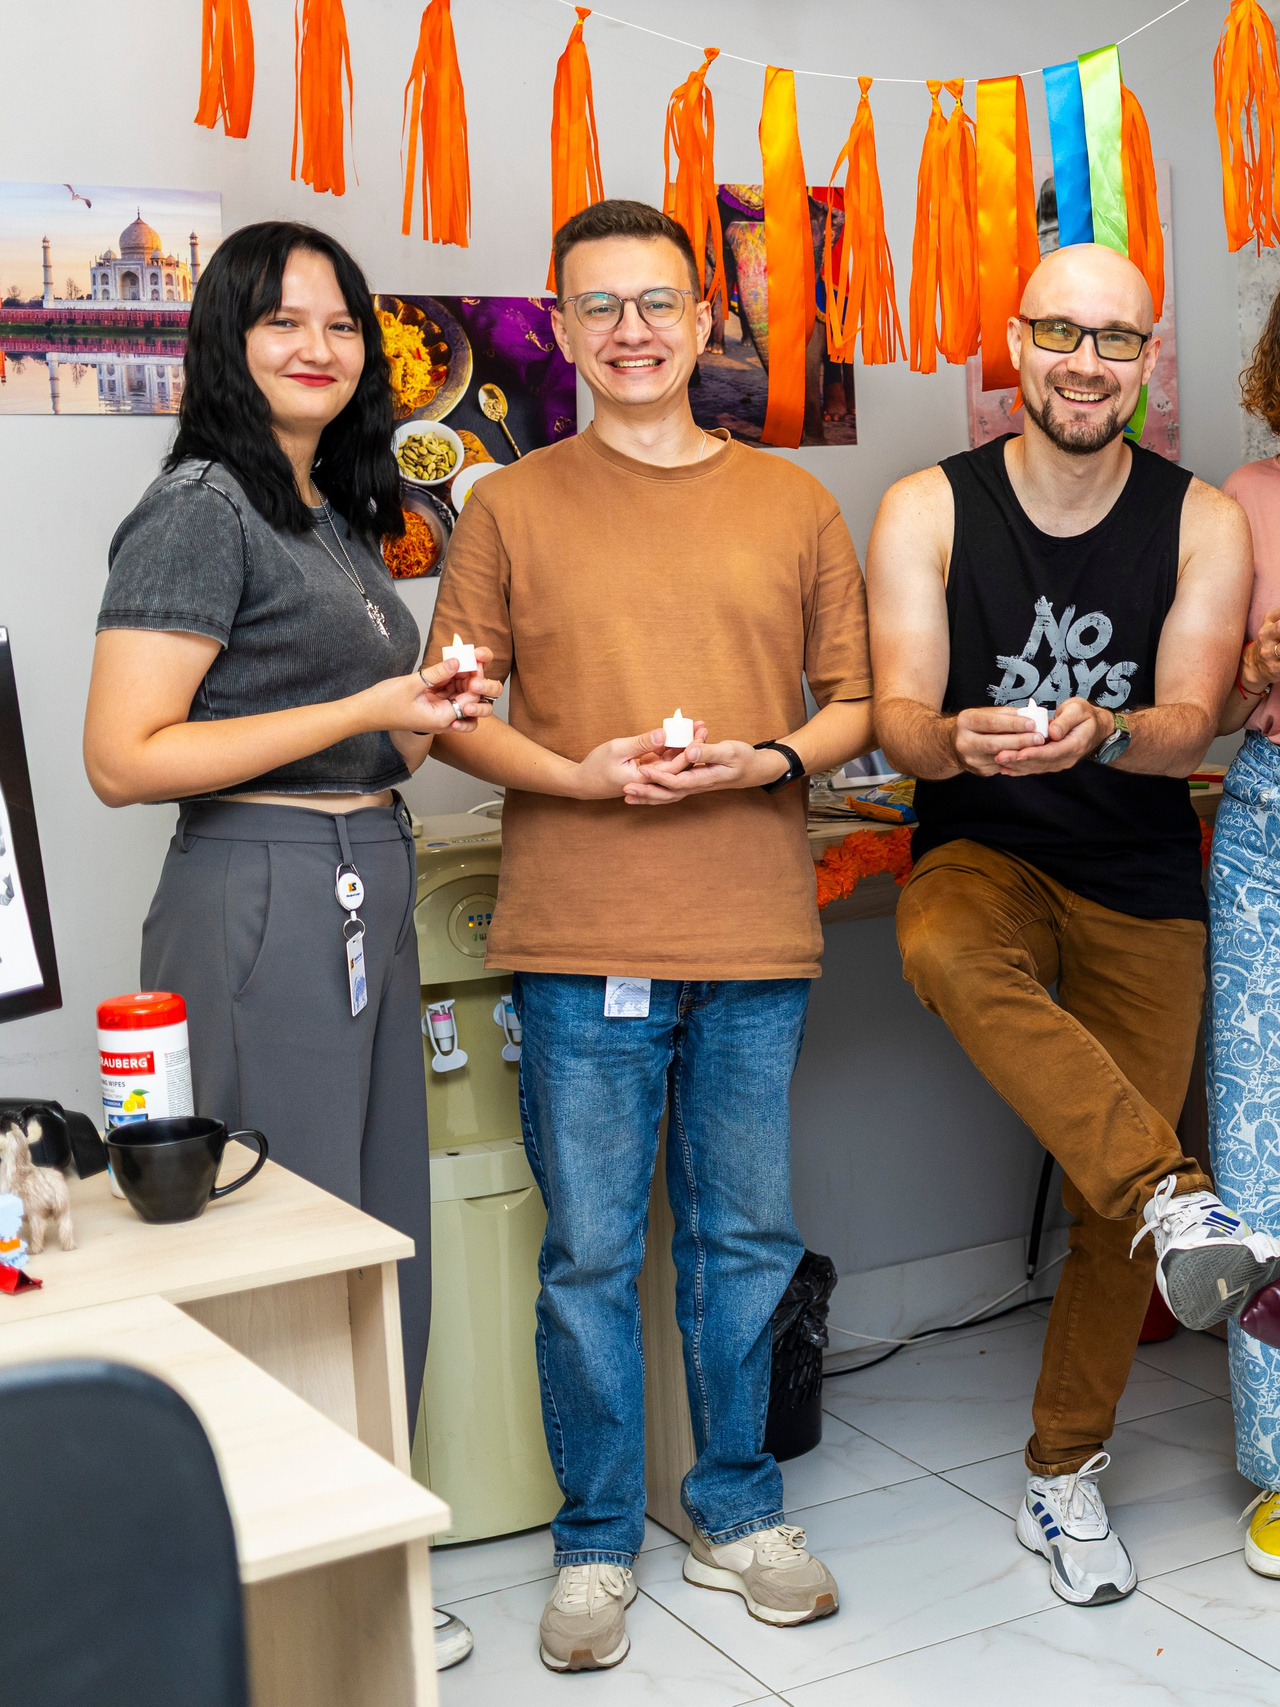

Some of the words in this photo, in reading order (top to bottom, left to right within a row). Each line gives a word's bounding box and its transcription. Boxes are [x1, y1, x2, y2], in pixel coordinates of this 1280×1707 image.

[1021, 595, 1113, 662] NO
[986, 659, 1139, 709] DAYS
[100, 1055, 148, 1069] RAUBERG
[108, 1080, 126, 1088] WIPES
